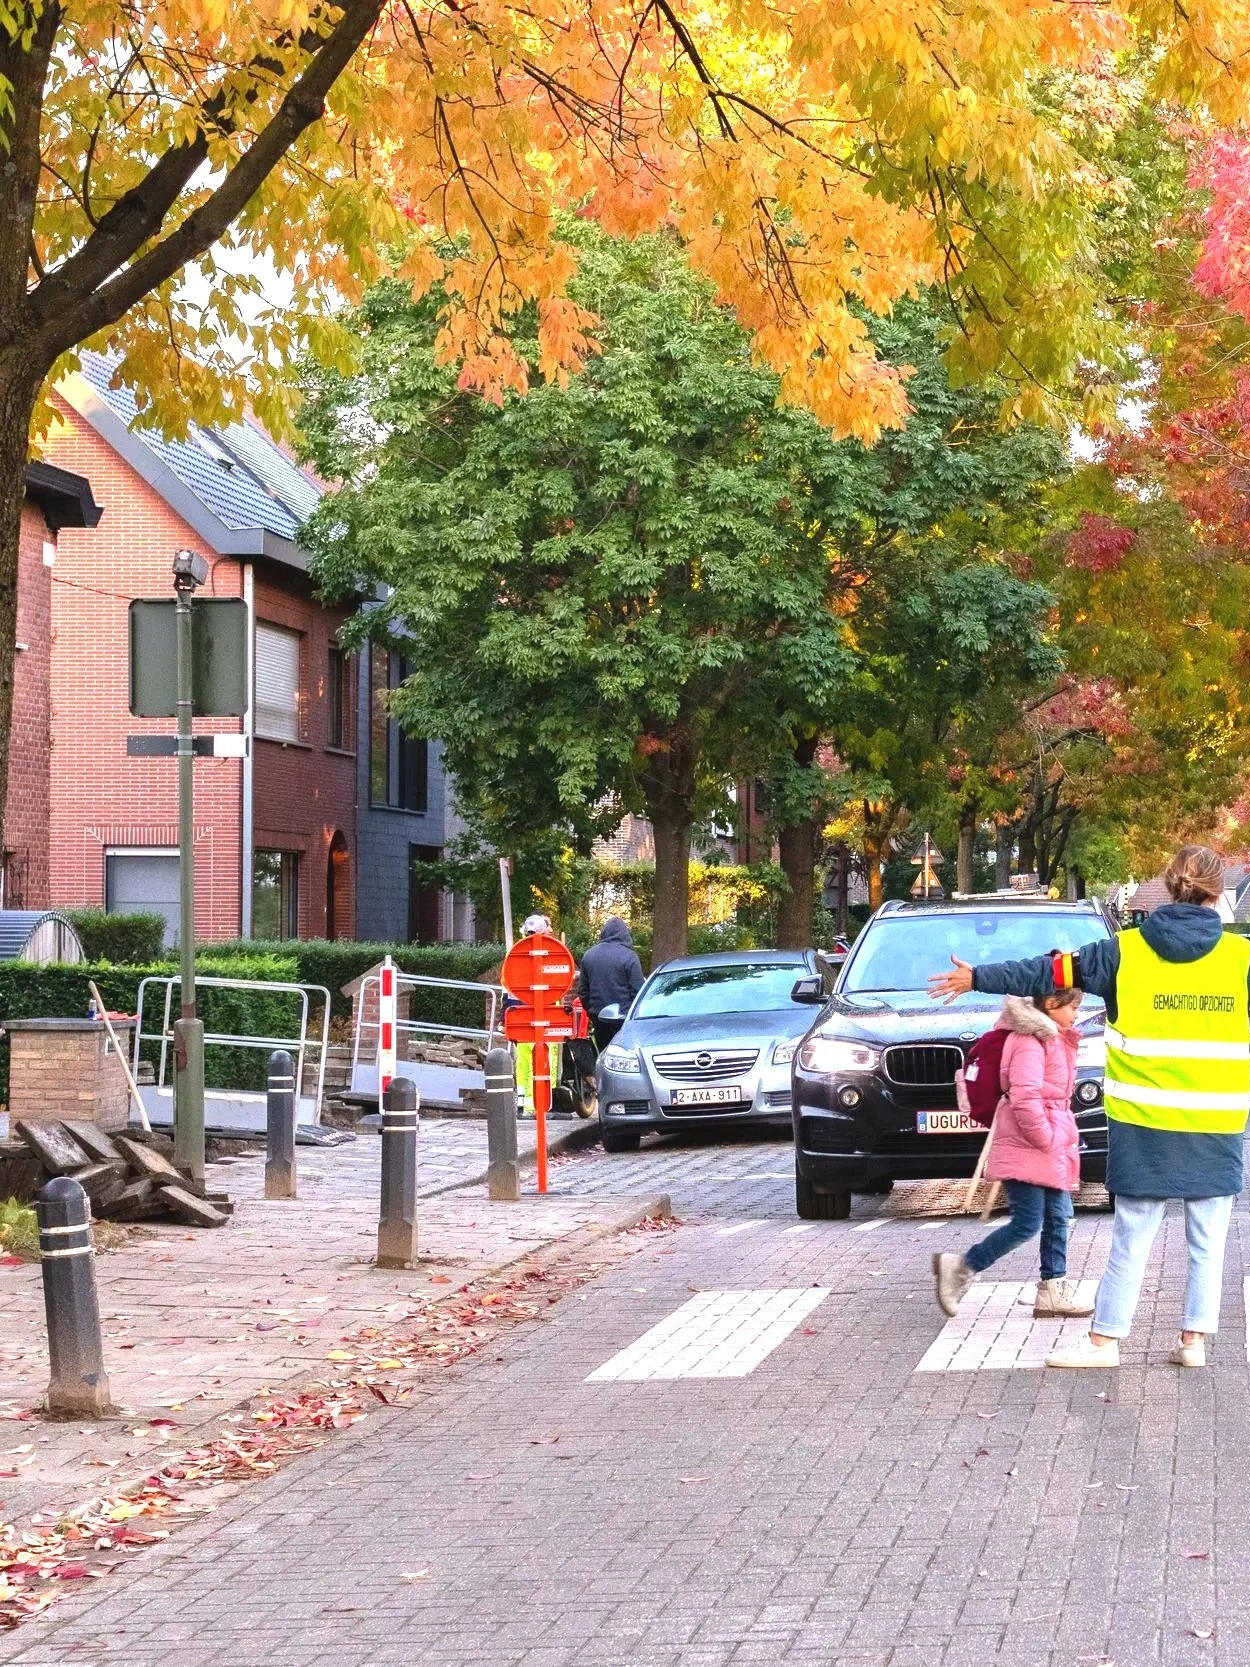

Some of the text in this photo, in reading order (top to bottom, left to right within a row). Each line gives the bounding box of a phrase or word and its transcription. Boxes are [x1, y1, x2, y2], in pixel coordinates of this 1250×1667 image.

[1153, 994, 1235, 1012] GEMACHTIGD OPZICHTER
[678, 1089, 737, 1102] 2-AXA-911
